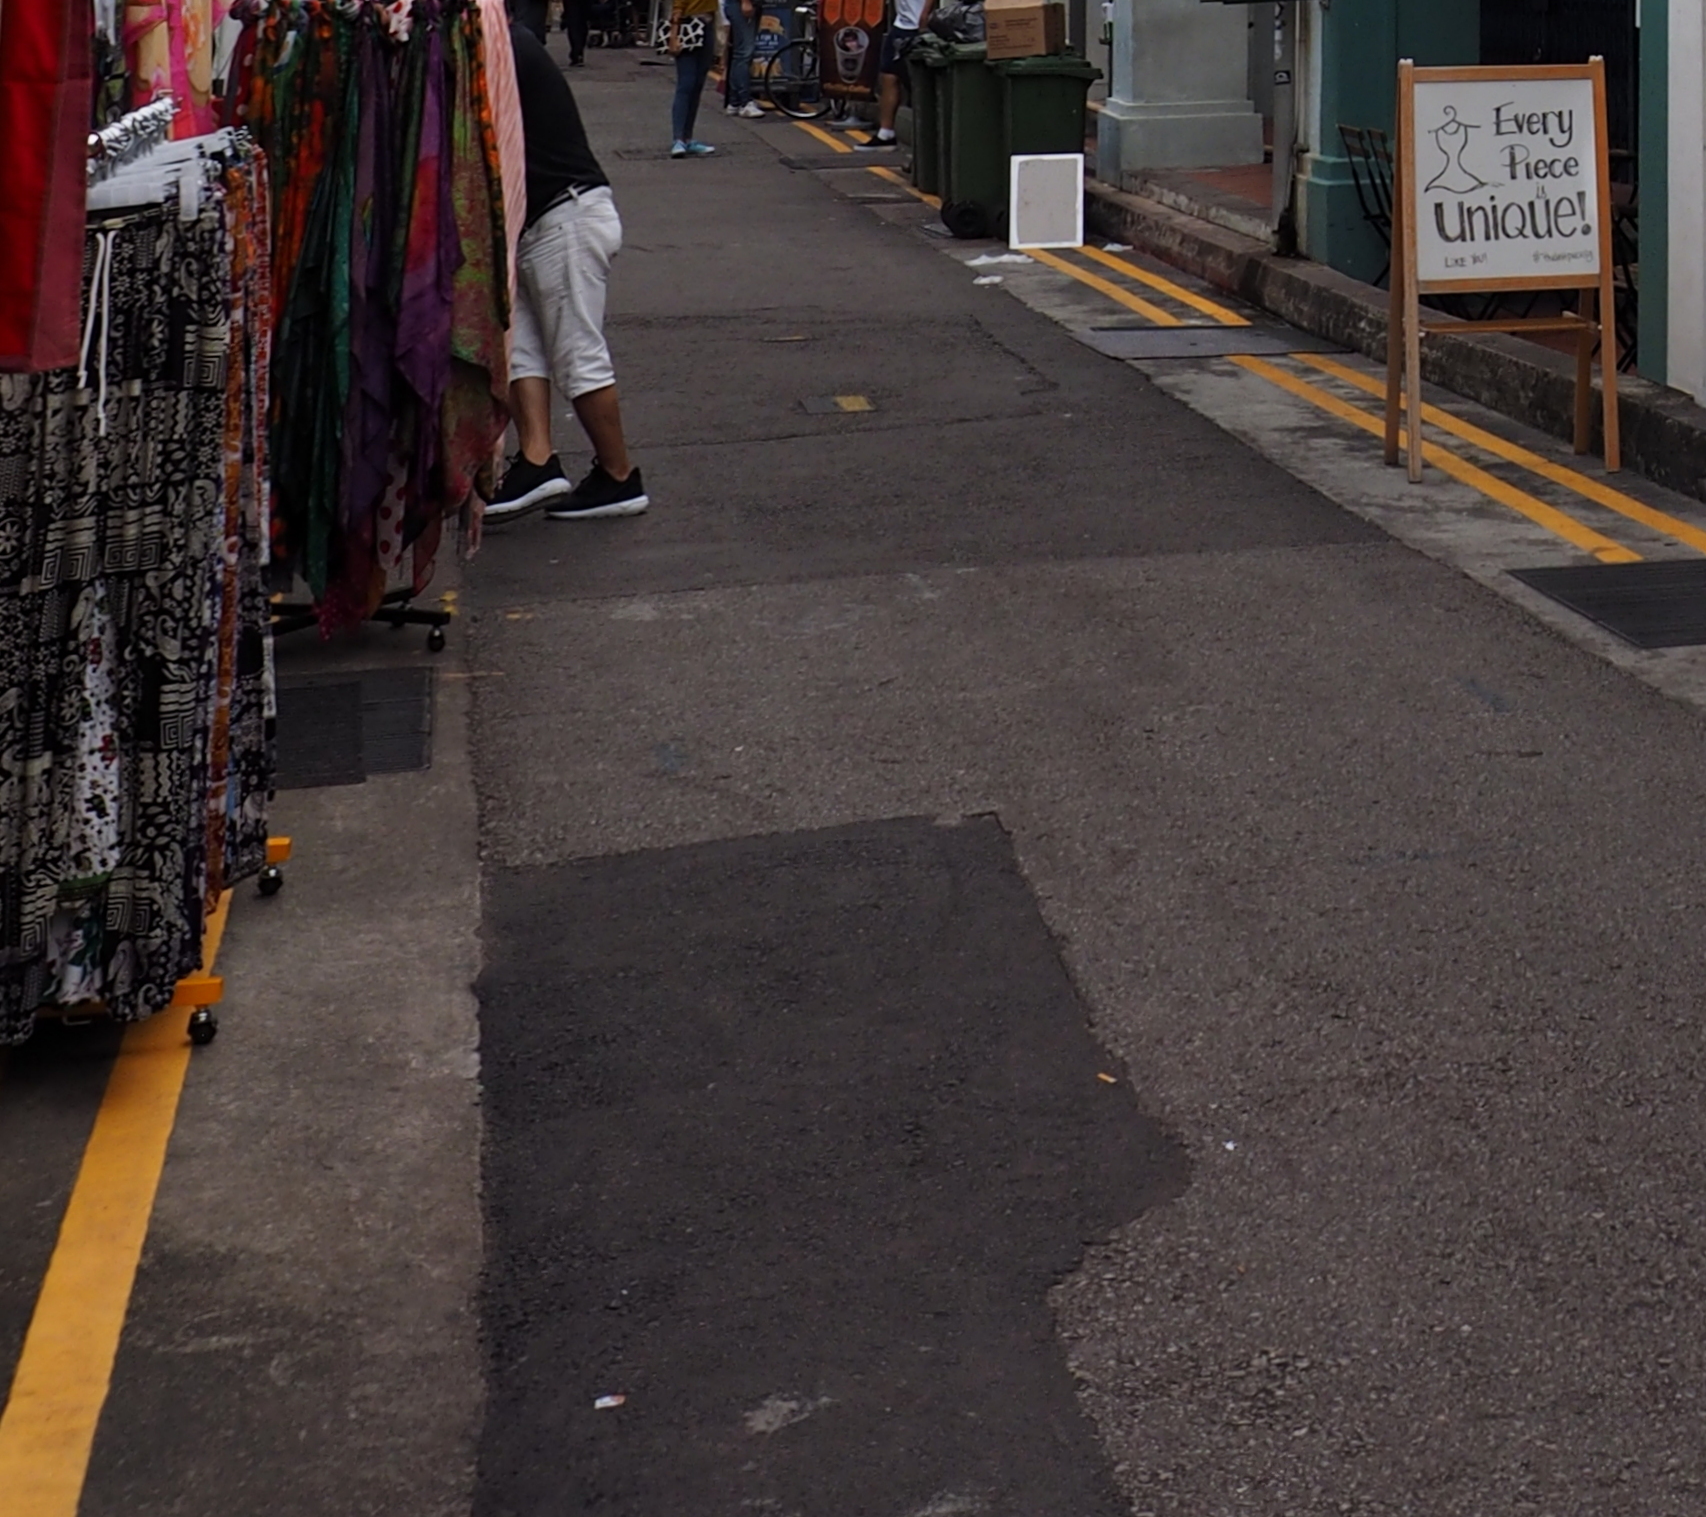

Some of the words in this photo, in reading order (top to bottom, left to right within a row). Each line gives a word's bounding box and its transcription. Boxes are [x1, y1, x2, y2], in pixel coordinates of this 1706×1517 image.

[1492, 101, 1573, 148] Every
[1500, 143, 1580, 181] Piece
[1536, 183, 1548, 200] is
